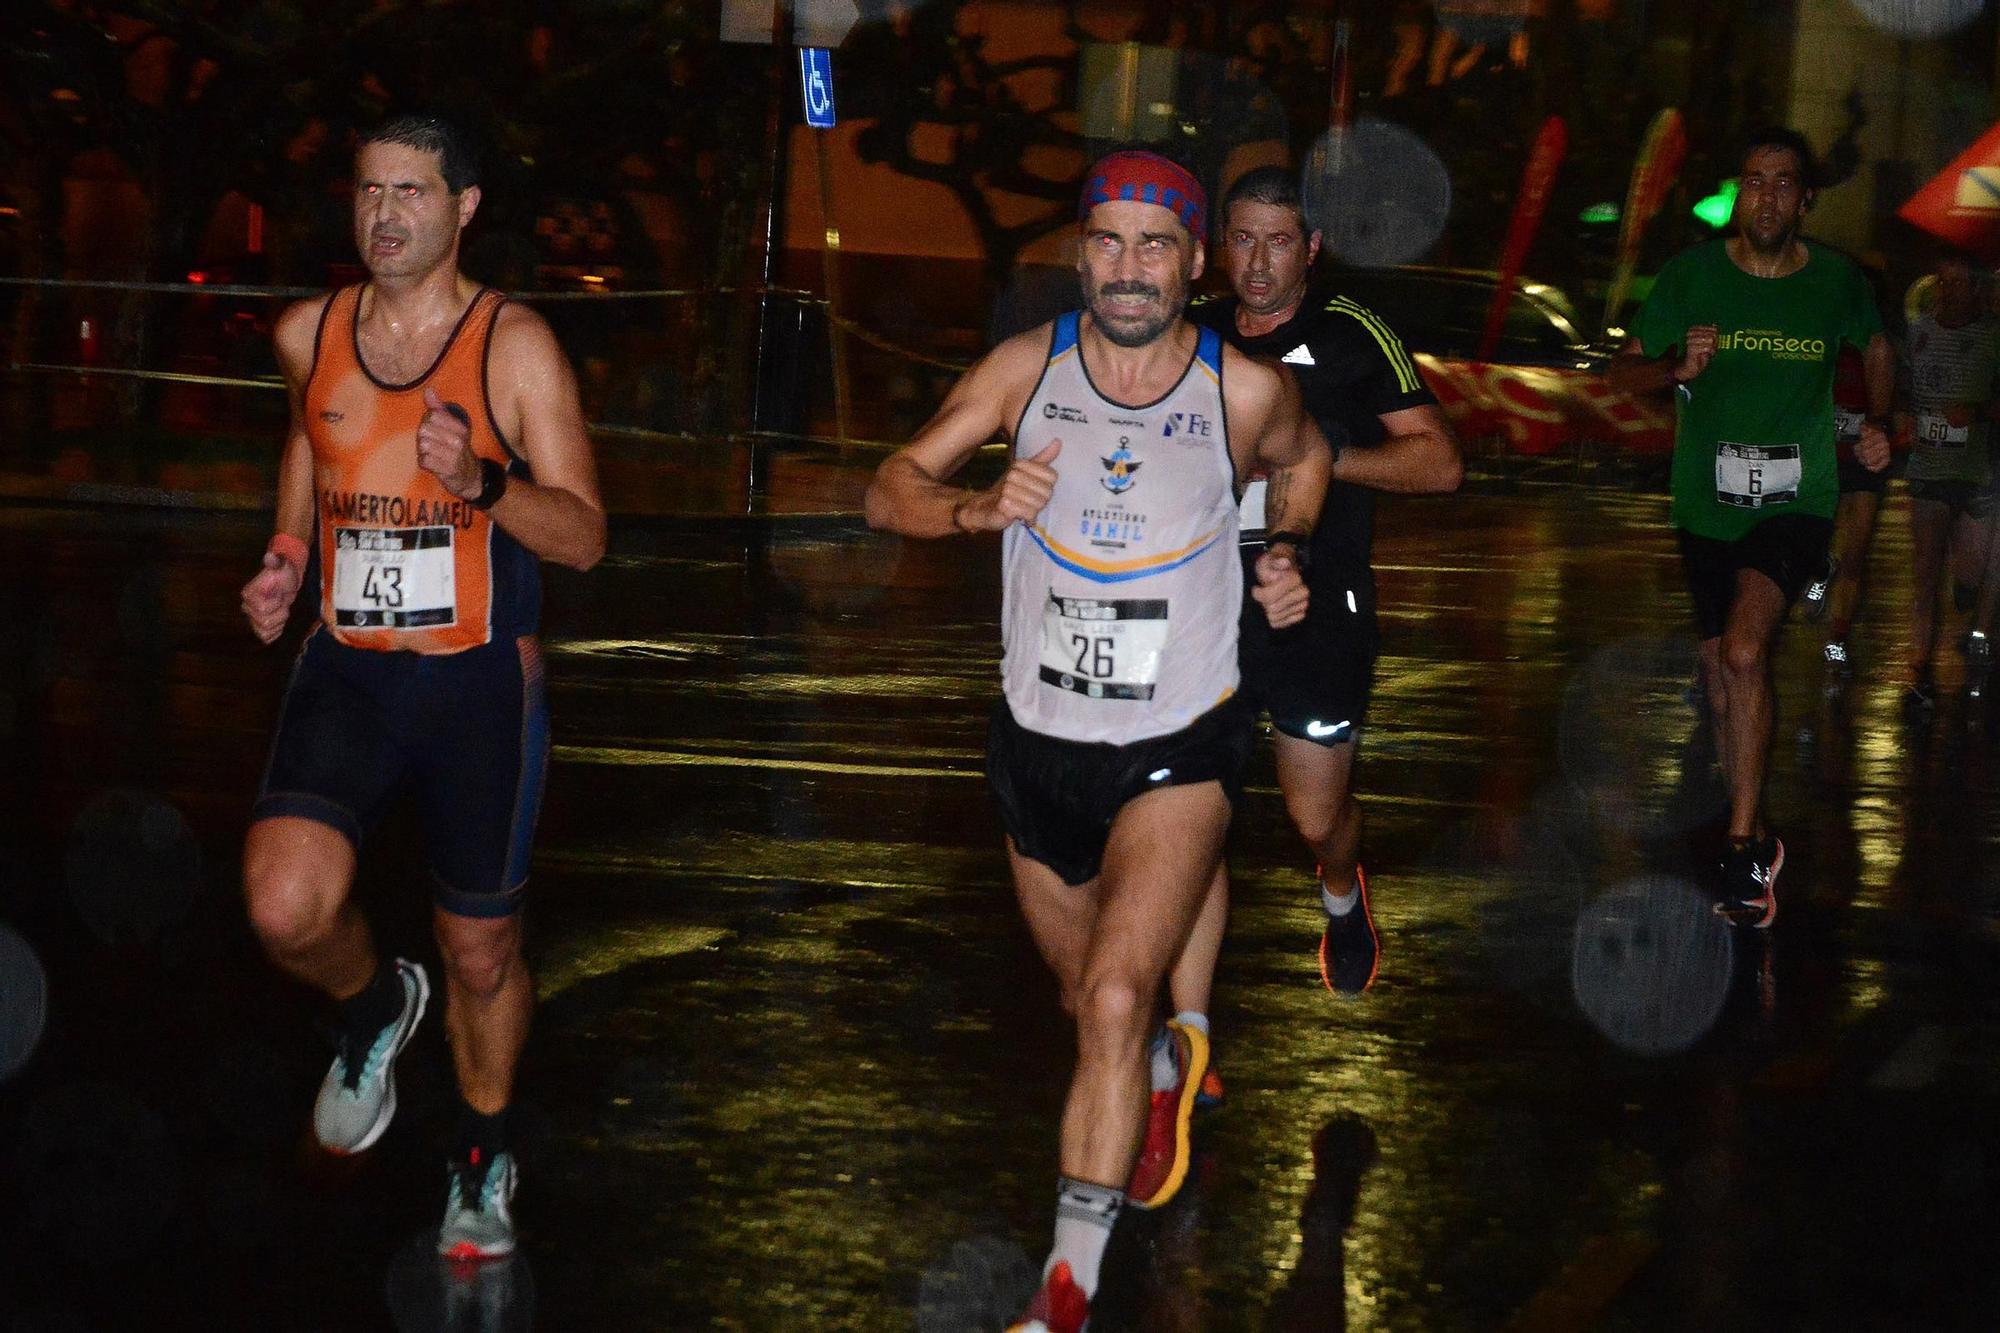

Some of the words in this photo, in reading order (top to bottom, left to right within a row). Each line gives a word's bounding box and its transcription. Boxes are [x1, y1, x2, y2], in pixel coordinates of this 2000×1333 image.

[1928, 422, 1949, 441] 60
[1749, 469, 1762, 495] 6
[1081, 519, 1142, 541] SAMIL
[362, 565, 403, 607] 43
[1071, 633, 1114, 678] 26
